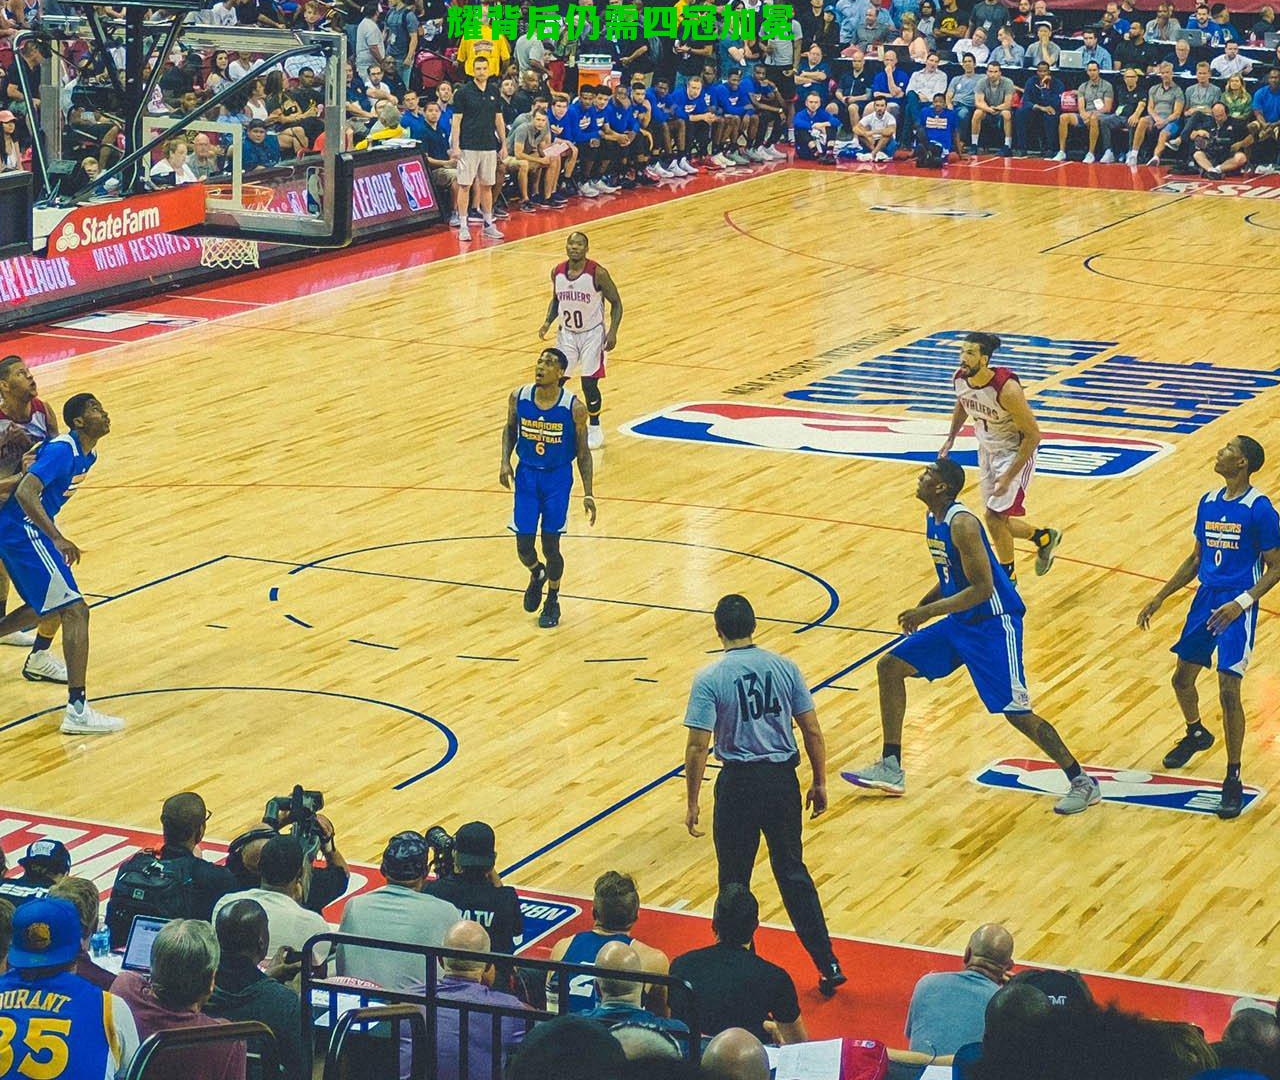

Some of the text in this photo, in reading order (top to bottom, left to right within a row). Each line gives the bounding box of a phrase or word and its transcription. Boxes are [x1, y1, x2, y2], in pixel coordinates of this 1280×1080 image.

[358, 172, 402, 218] LEAGUE
[92, 242, 129, 272] MGM
[128, 231, 193, 263] RESORTS
[563, 310, 583, 328] 20
[535, 441, 545, 455] 6
[1215, 549, 1222, 567] 0
[942, 566, 950, 584] 5
[734, 671, 782, 722] 134
